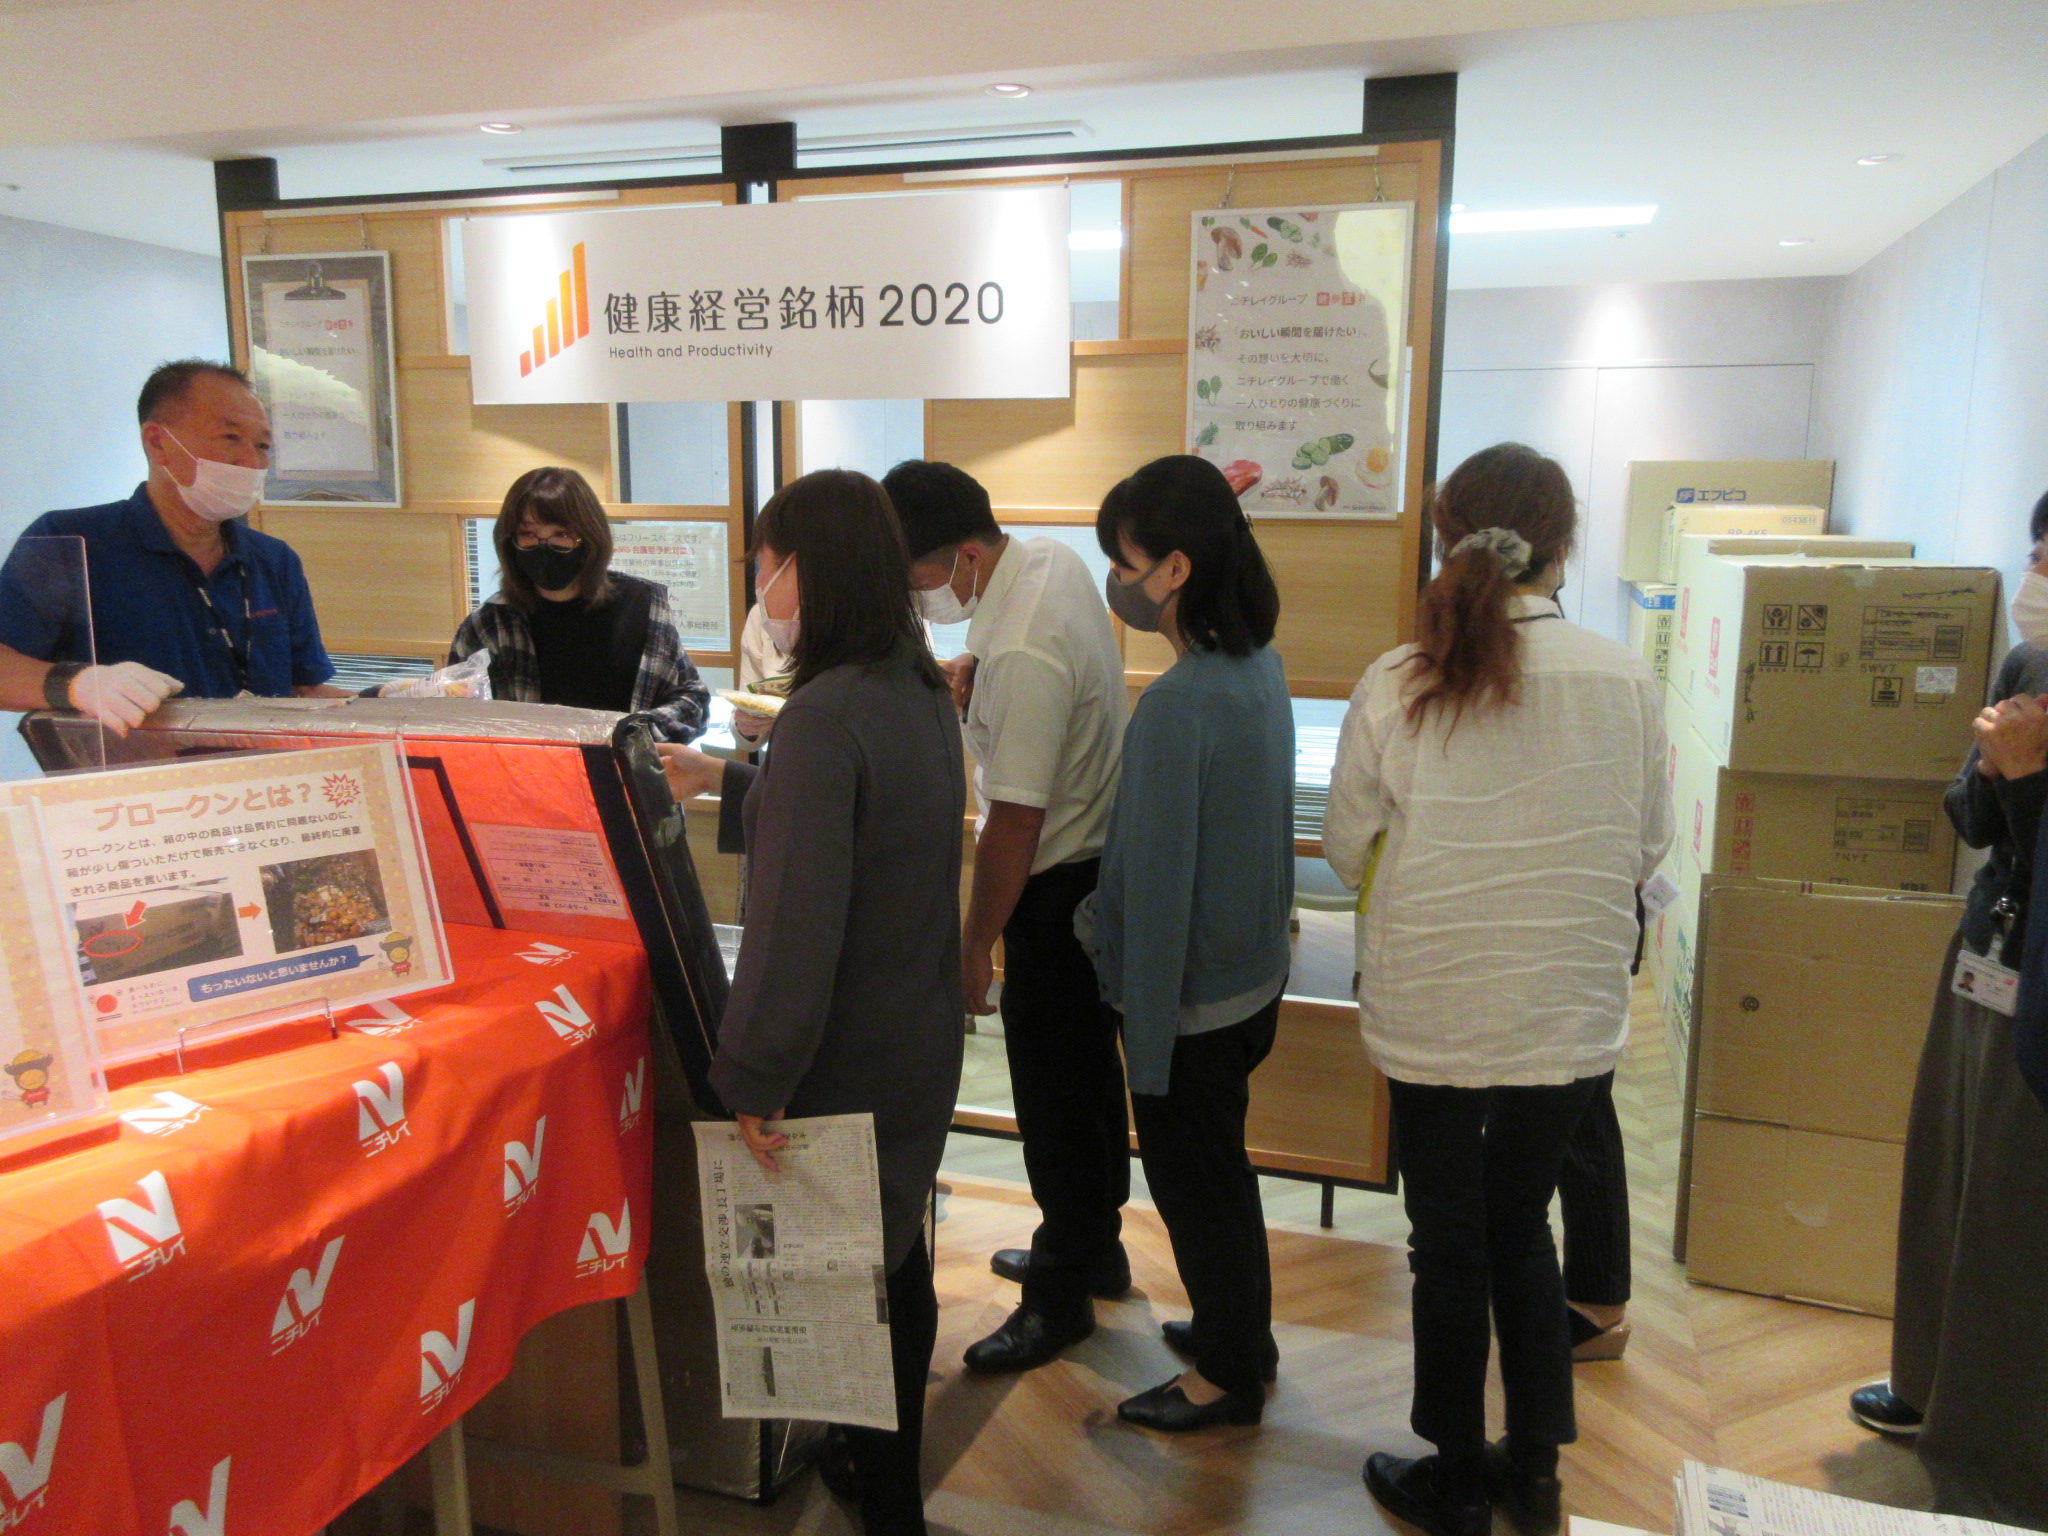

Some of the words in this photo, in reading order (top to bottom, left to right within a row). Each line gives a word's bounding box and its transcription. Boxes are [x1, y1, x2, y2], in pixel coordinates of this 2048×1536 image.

[609, 346, 653, 359] Health
[657, 345, 682, 358] and
[688, 343, 773, 358] Productivity
[1236, 374, 1349, 387] ニチレイグループで働く
[1236, 396, 1361, 409] 一人ひとりの健康づくりに
[1234, 420, 1297, 432] 取り組みます
[1697, 490, 1746, 502] エフピコ
[70, 871, 197, 897] される商品を言います。
[564, 1023, 598, 1046] ニチレイ
[361, 1120, 412, 1158] ニチレイ
[506, 1180, 539, 1218] ニチレイ
[125, 1236, 187, 1282] ニチレイ
[576, 1255, 629, 1278] ニチレイ
[271, 1309, 322, 1356] ニチレイ
[421, 1369, 464, 1415] ニチレイ
[0, 1485, 49, 1535] チレイ
